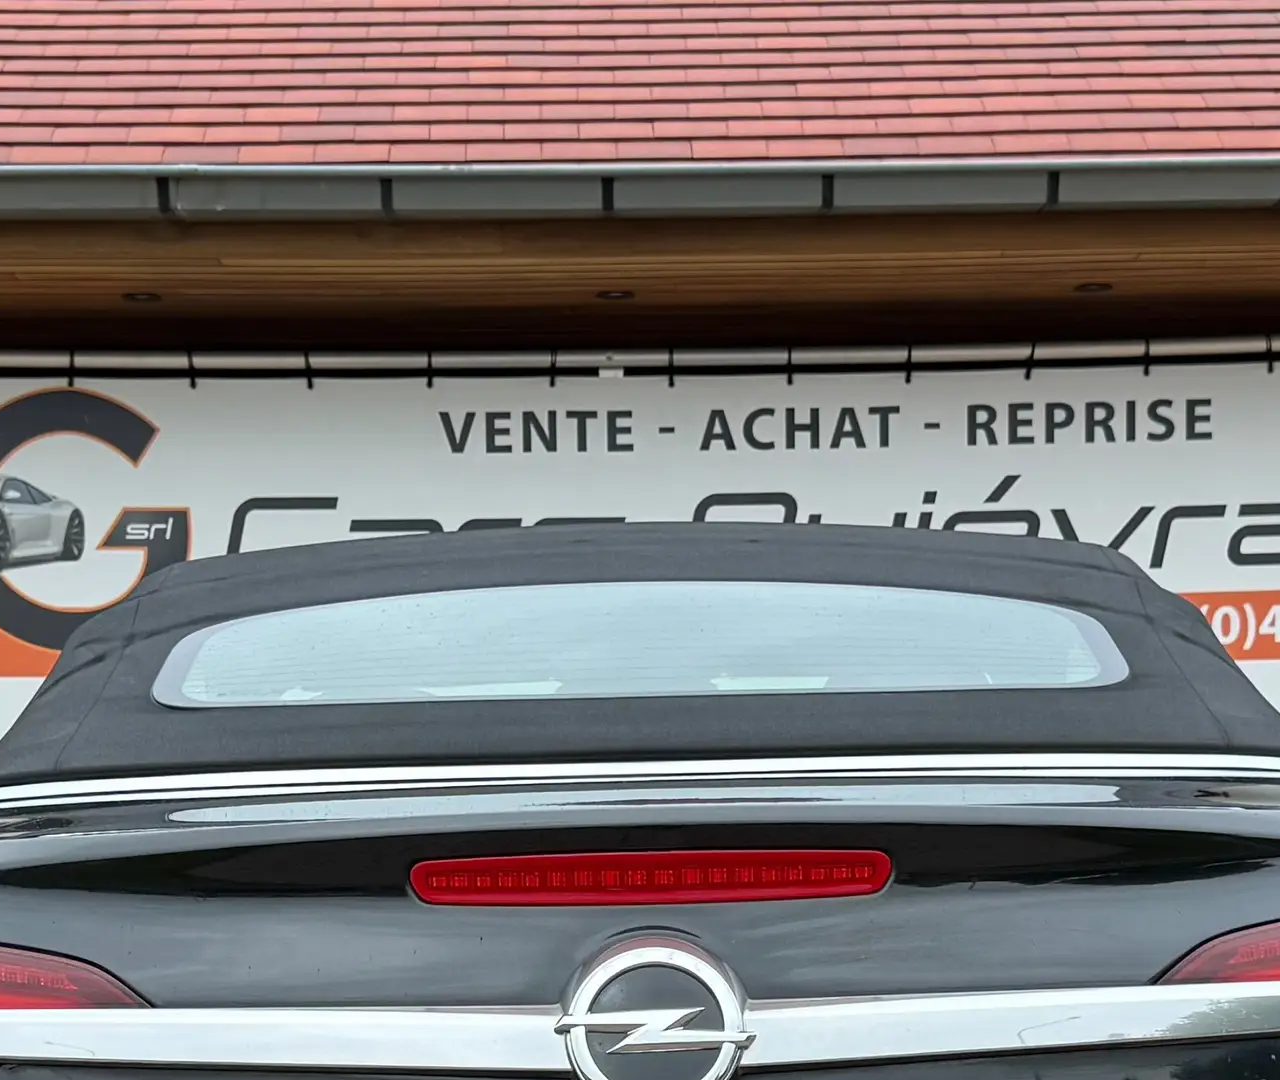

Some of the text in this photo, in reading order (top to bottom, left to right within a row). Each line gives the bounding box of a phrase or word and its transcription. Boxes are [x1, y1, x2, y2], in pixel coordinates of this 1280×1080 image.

[438, 410, 635, 453] VENTE
[699, 405, 901, 452] ACHAT
[966, 397, 1213, 446] REPRISE
[125, 517, 174, 540] srl
